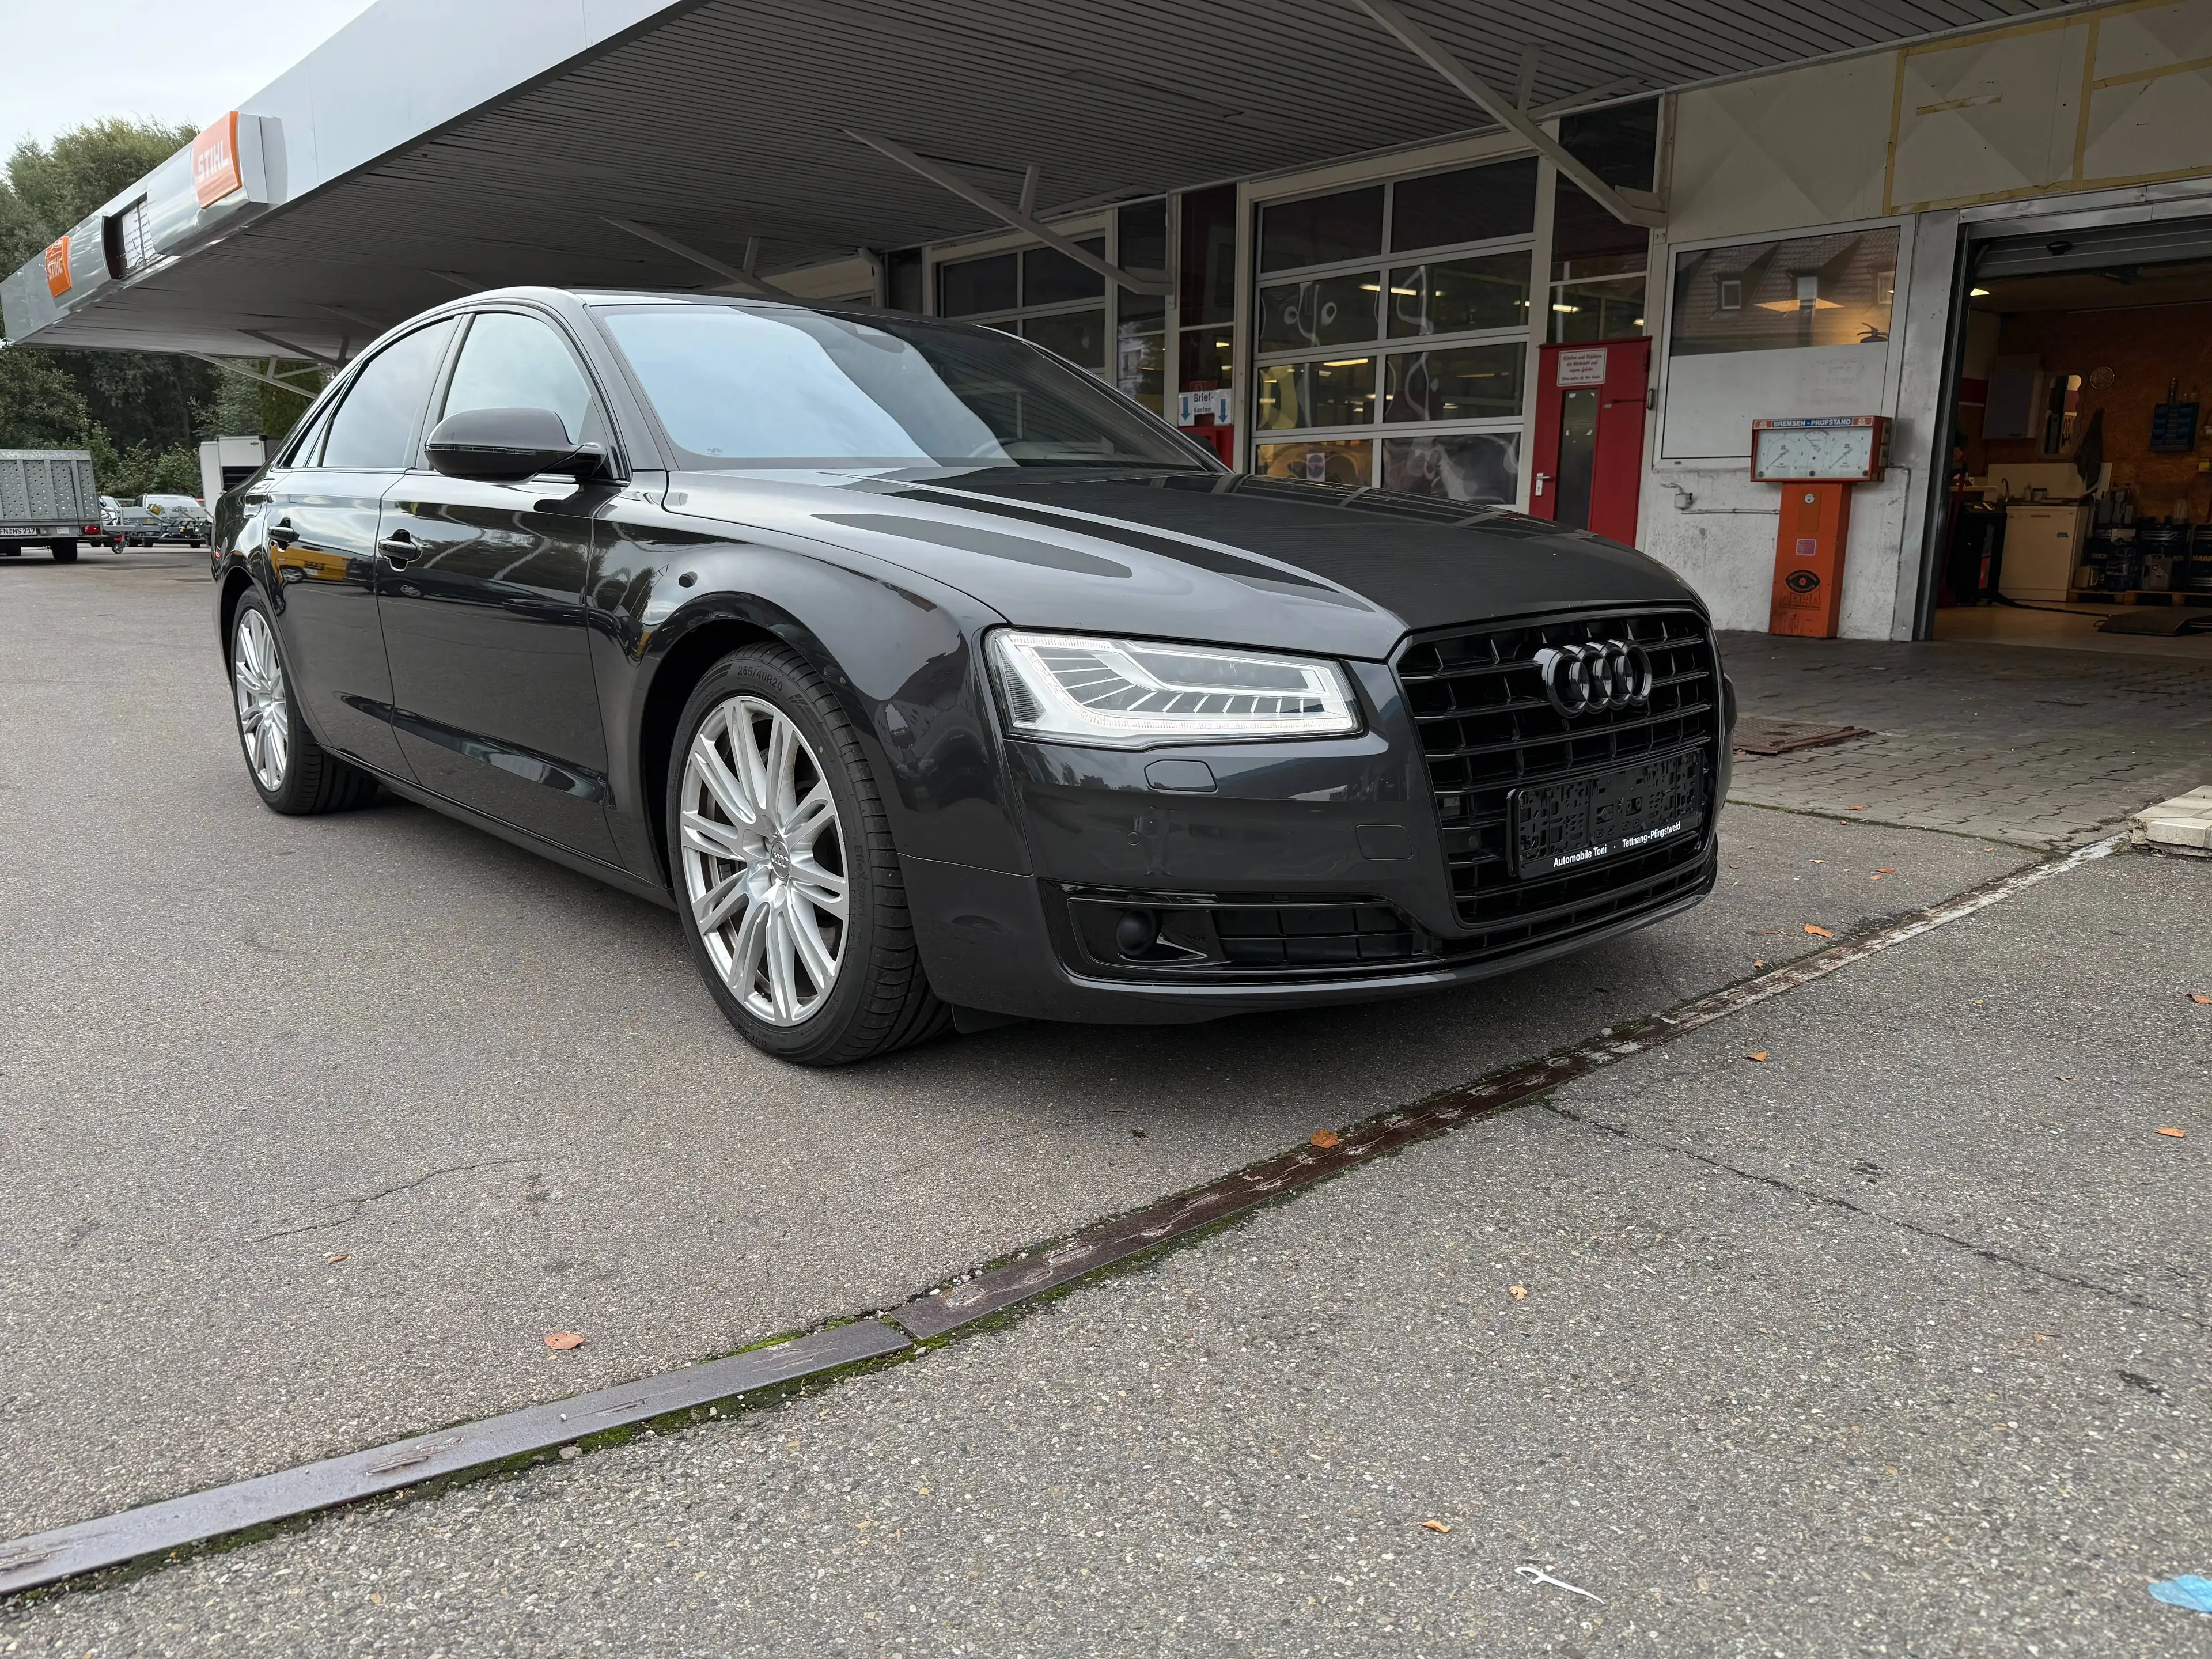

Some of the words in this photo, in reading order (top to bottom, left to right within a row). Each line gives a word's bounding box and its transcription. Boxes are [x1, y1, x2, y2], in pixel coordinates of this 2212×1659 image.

[198, 139, 228, 182] STIHL
[1194, 392, 1214, 402] Brief-
[737, 665, 783, 691] 265/40R20
[1554, 850, 1592, 868] Automobile
[1593, 844, 1607, 855] Toni
